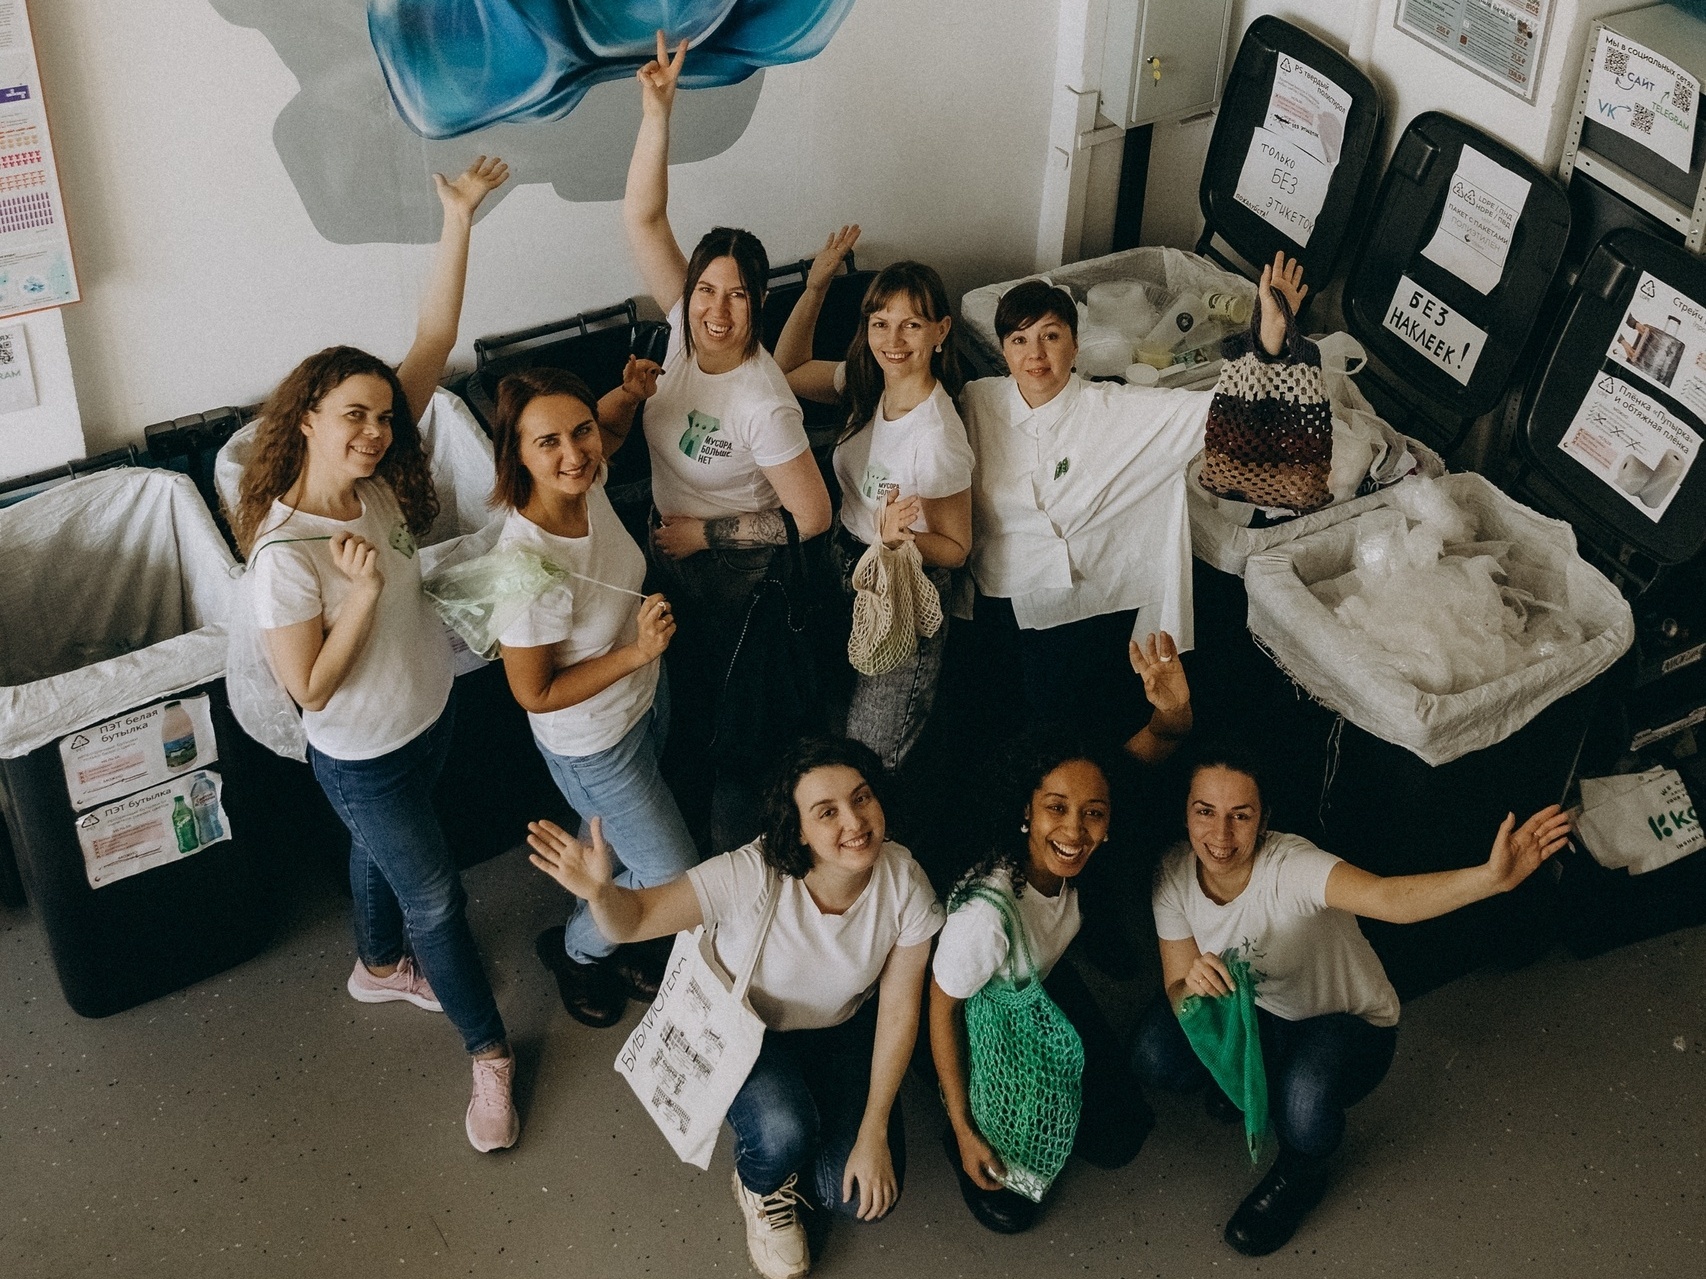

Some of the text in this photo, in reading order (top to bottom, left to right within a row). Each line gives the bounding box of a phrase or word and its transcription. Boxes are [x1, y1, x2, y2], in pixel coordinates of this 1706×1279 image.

[1606, 36, 1619, 48] Мы
[1628, 48, 1675, 76] социальных
[1295, 64, 1329, 91] PS твердый
[1627, 72, 1655, 91] САЙТ
[1317, 88, 1346, 114] полистирол
[1599, 99, 1615, 119] VK
[1652, 102, 1689, 132] TELEGRAM
[1261, 143, 1295, 169] ТОЛЬКО
[1272, 168, 1298, 194] БЕЗ
[1266, 197, 1314, 233] ЭТИКЕТОК
[1476, 205, 1493, 217] HDPE
[1498, 217, 1510, 229] ПВД
[1478, 196, 1495, 209] LDPE
[1500, 208, 1513, 221] ПНД
[1448, 203, 1468, 219] ПАКЕТ
[1473, 221, 1508, 245] ПАКЕТАМИ
[1452, 217, 1500, 251] ПОЛИЭТИЛЕН
[1409, 291, 1449, 326] БЕЗ
[1673, 297, 1703, 322] Стрейч
[1614, 396, 1621, 404] и
[1622, 400, 1662, 433] обтяжная
[1663, 430, 1689, 454] плёнка
[1619, 385, 1651, 412] Плёнка
[1653, 409, 1693, 444] «Пупырка»
[698, 455, 713, 464] НЕТ
[100, 710, 158, 734] ПЭТ белая
[101, 722, 149, 742] бутылка
[105, 805, 125, 816] ПЭТ
[128, 788, 171, 809] бутылка
